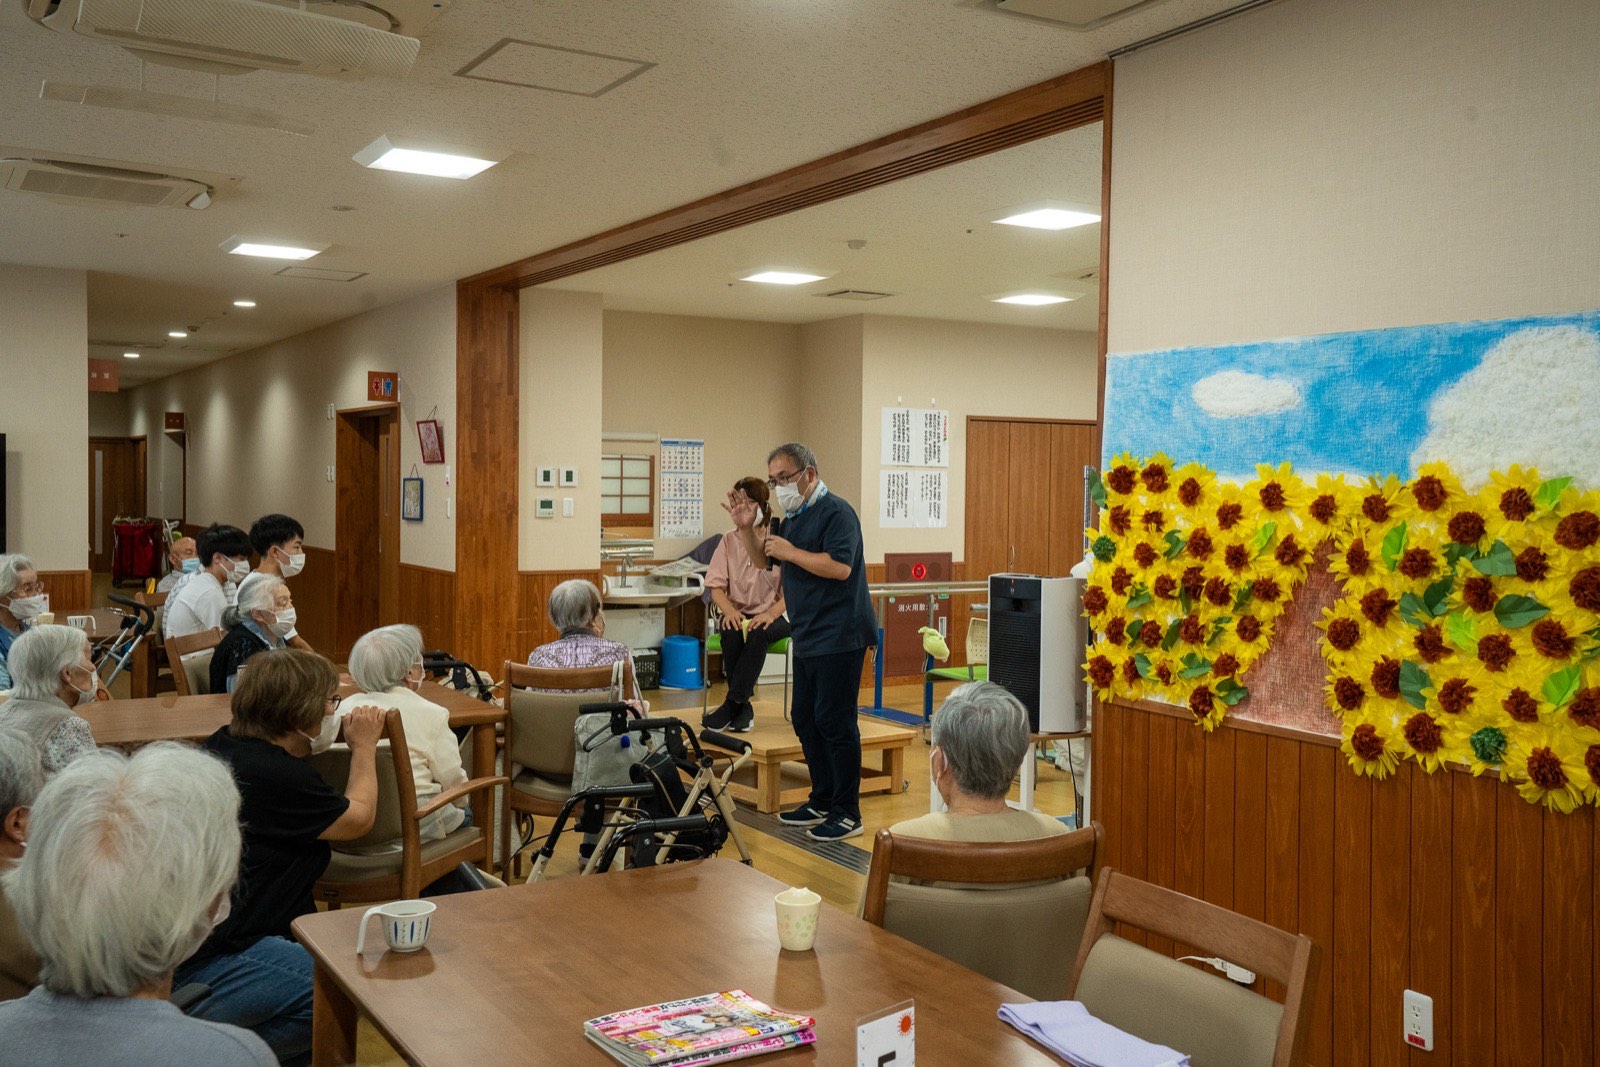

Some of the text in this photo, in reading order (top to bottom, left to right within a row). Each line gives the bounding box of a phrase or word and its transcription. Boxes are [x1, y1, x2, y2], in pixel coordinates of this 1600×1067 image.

[898, 603, 940, 612] 消火用散栓
